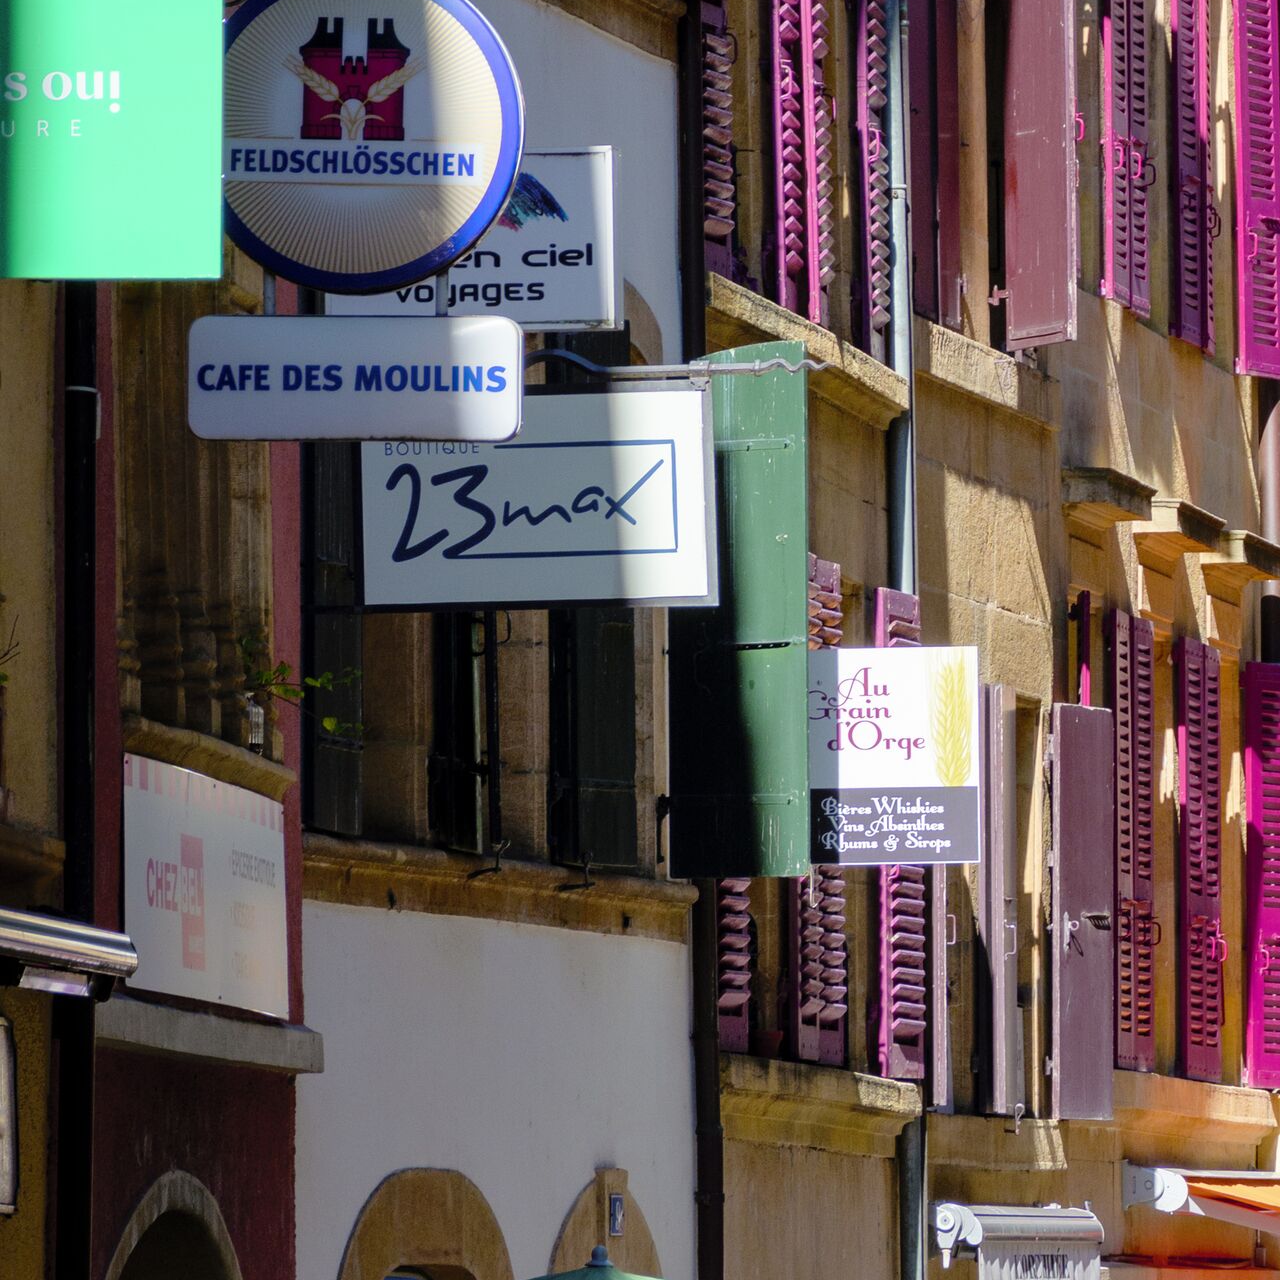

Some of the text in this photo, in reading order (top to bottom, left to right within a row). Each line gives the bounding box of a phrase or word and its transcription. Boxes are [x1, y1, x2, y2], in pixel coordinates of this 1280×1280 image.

[230, 145, 475, 177] FELDSCHLÖSSCHEN
[521, 242, 593, 267] ciel
[196, 364, 507, 393] CAFE DES MOULINS
[829, 667, 890, 707] Au
[809, 691, 892, 720] Grain
[827, 721, 926, 760] d'Orge
[821, 796, 944, 816] Bières Whiskies
[828, 815, 944, 836] Vins Absinthes
[821, 831, 951, 853] Rhums & Sirops
[146, 858, 178, 912] CHEZ
